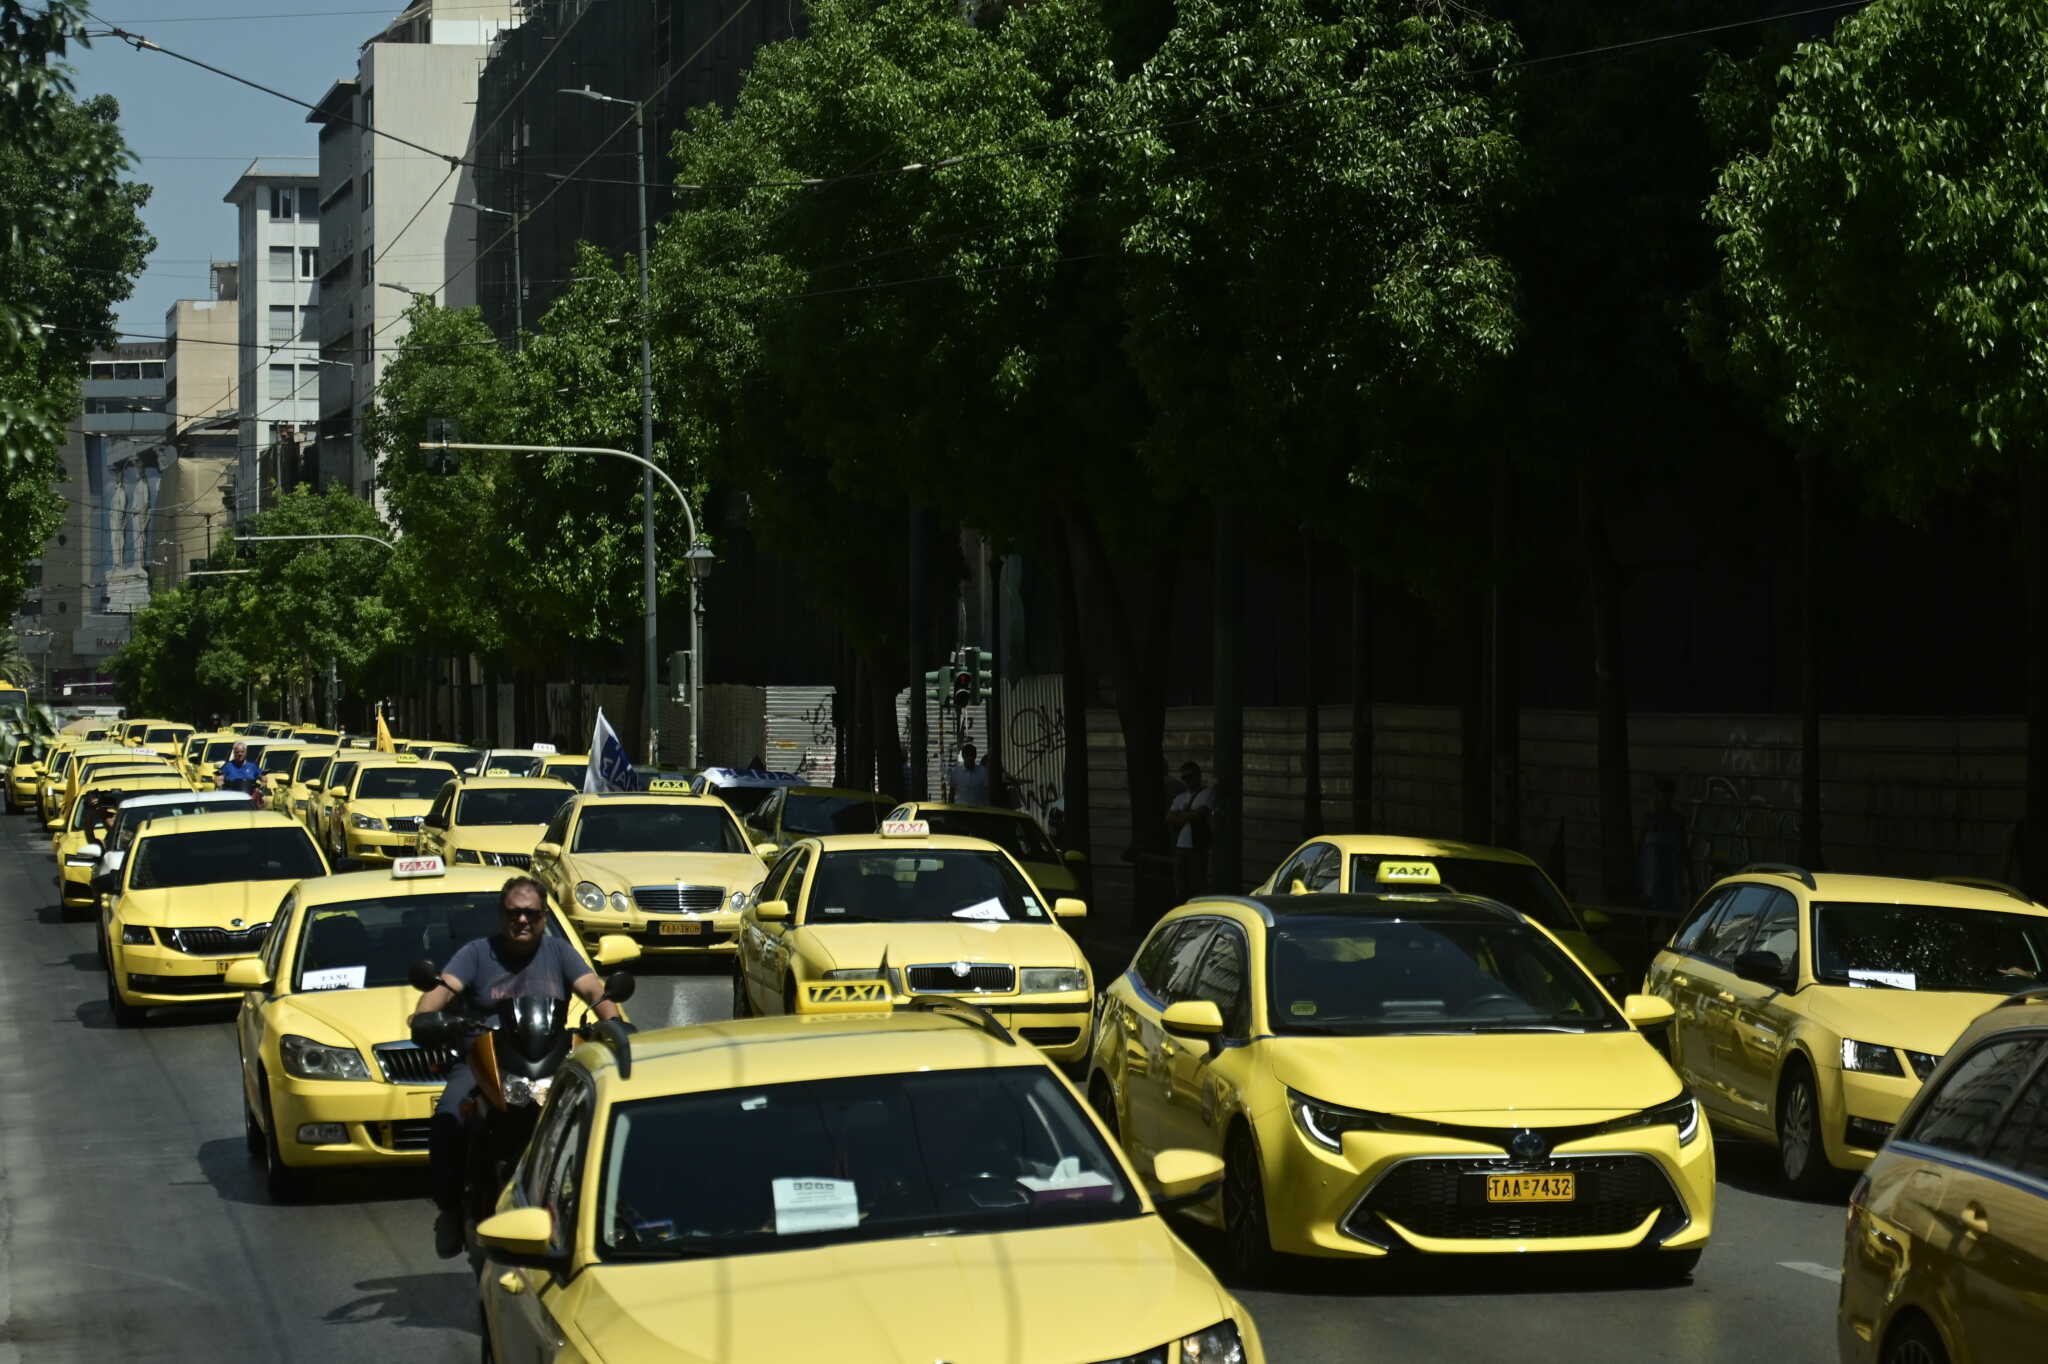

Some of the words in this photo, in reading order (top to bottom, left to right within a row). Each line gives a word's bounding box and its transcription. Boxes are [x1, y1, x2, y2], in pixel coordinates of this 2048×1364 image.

[653, 781, 685, 789] TAXI
[886, 823, 924, 834] TAXI
[399, 860, 437, 871] TAXI
[1386, 866, 1430, 876] TAXI
[810, 985, 881, 1002] TAXI
